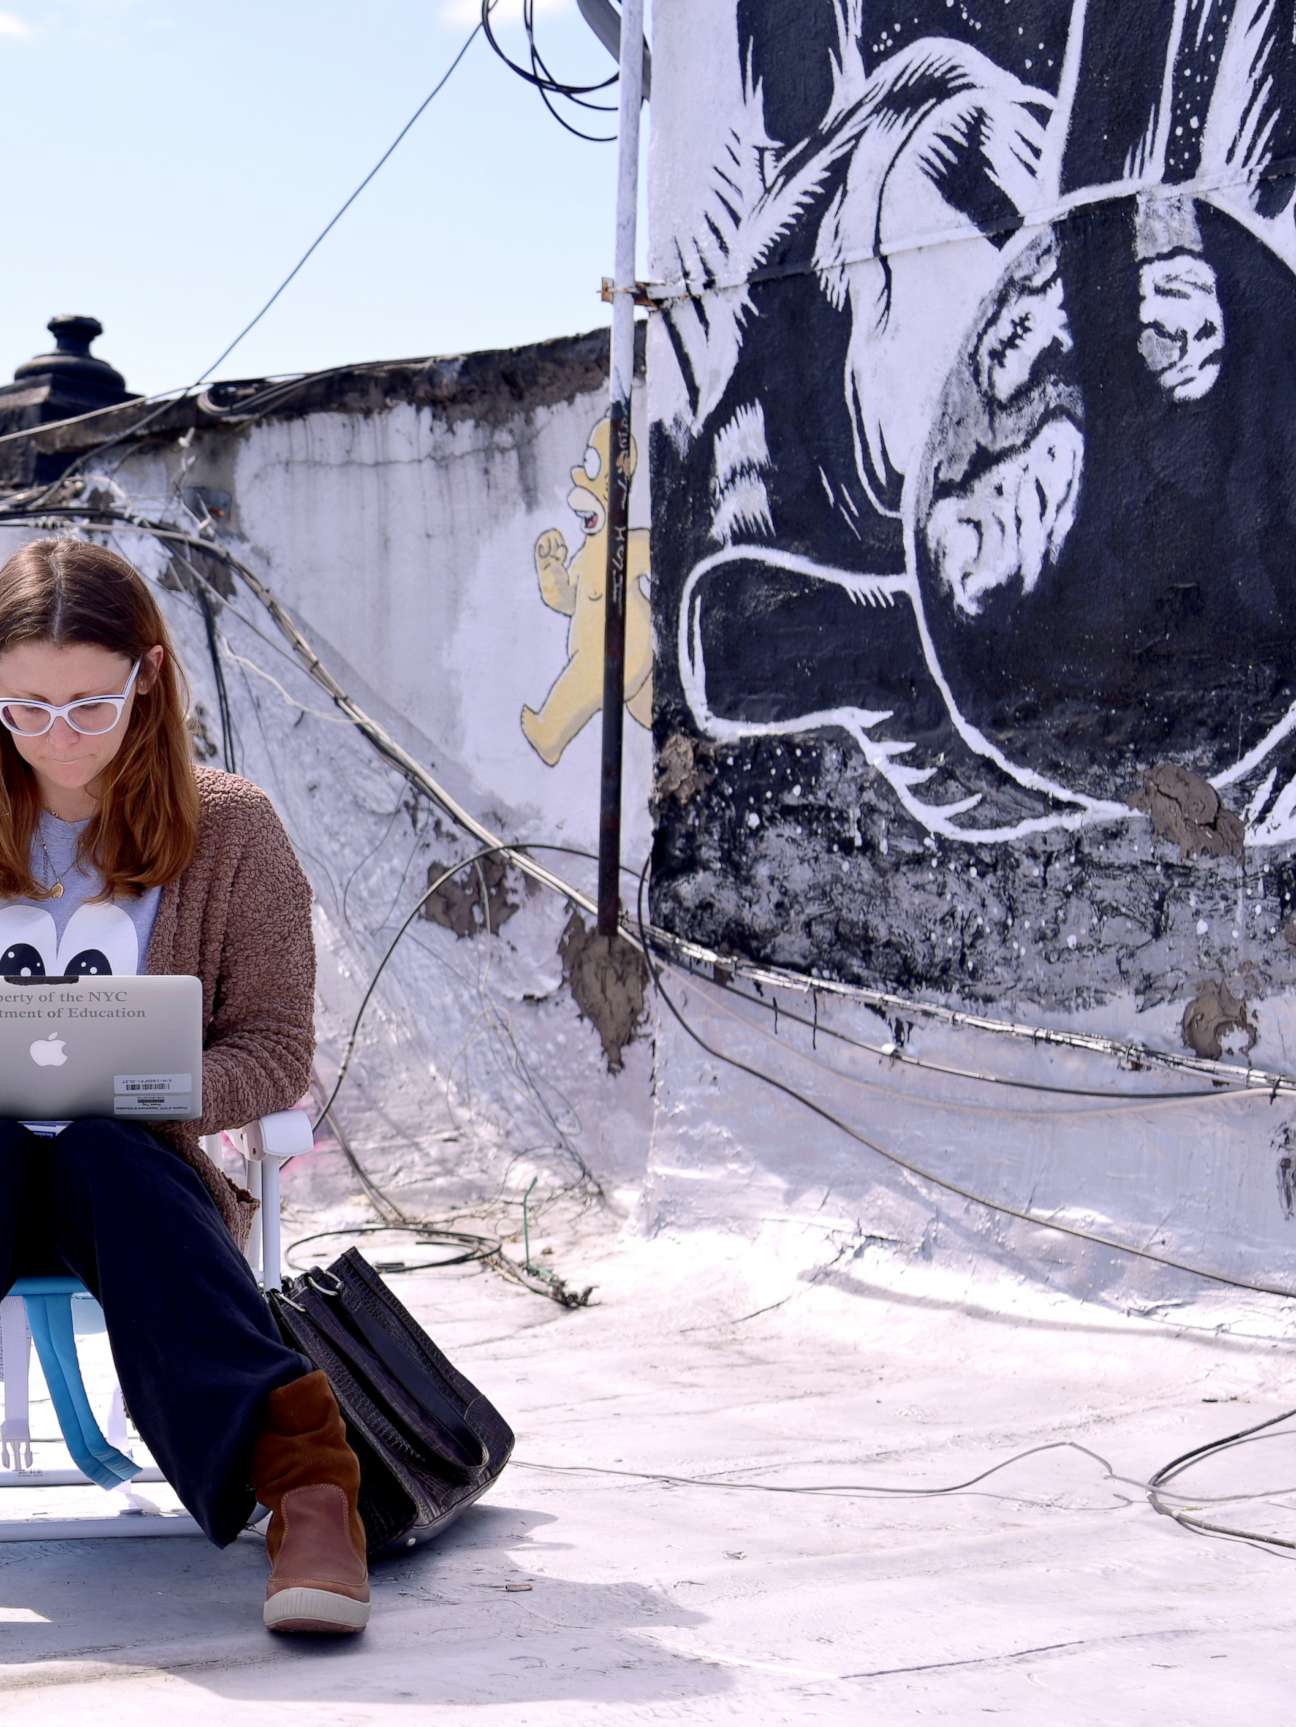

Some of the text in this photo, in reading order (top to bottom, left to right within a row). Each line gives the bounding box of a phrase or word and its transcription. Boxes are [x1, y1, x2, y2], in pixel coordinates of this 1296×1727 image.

[38, 991, 55, 1002] of
[59, 991, 84, 1002] the
[88, 991, 128, 1002] NYC
[47, 1007, 64, 1018] of
[68, 1007, 145, 1018] Education
